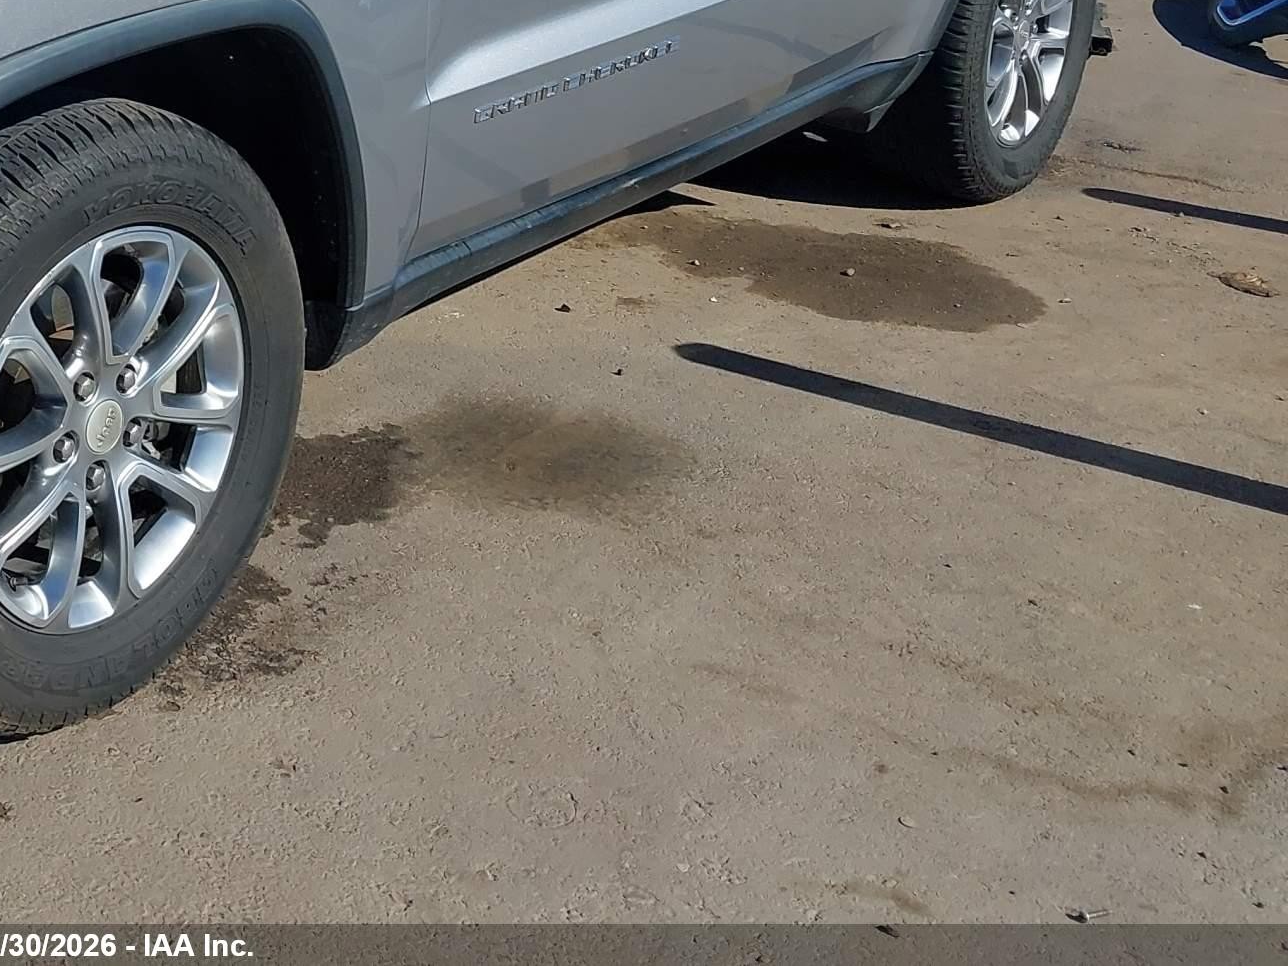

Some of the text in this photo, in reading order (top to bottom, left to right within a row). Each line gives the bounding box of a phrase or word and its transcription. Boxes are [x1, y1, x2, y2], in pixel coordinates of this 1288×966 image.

[473, 35, 681, 124] GRAND CHEROKEE
[83, 177, 258, 256] YOKOHAMA
